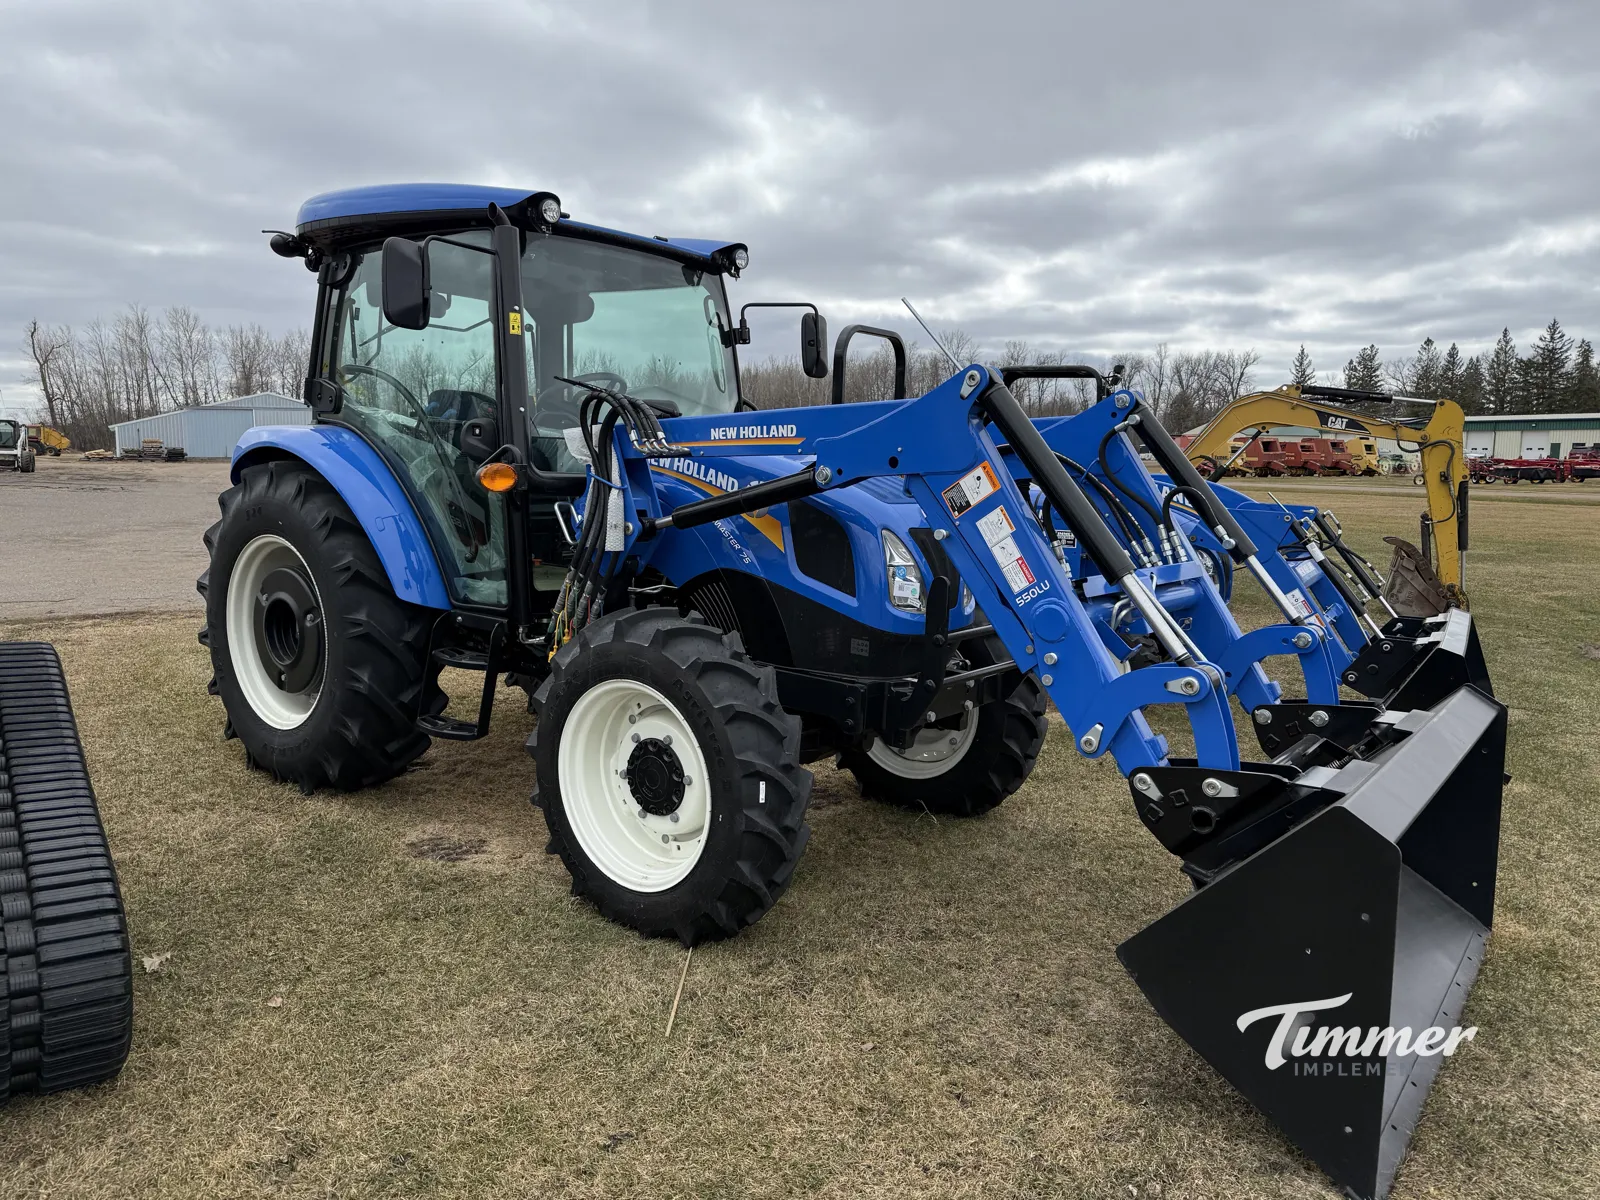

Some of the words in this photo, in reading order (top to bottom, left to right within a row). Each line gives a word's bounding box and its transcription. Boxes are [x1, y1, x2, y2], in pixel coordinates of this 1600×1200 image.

[1328, 416, 1349, 430] CAT
[710, 427, 737, 440] NEW
[739, 424, 797, 439] HOLLAND
[672, 457, 739, 493] HOLLAND
[739, 551, 752, 564] 75
[1015, 579, 1051, 608] 550LU
